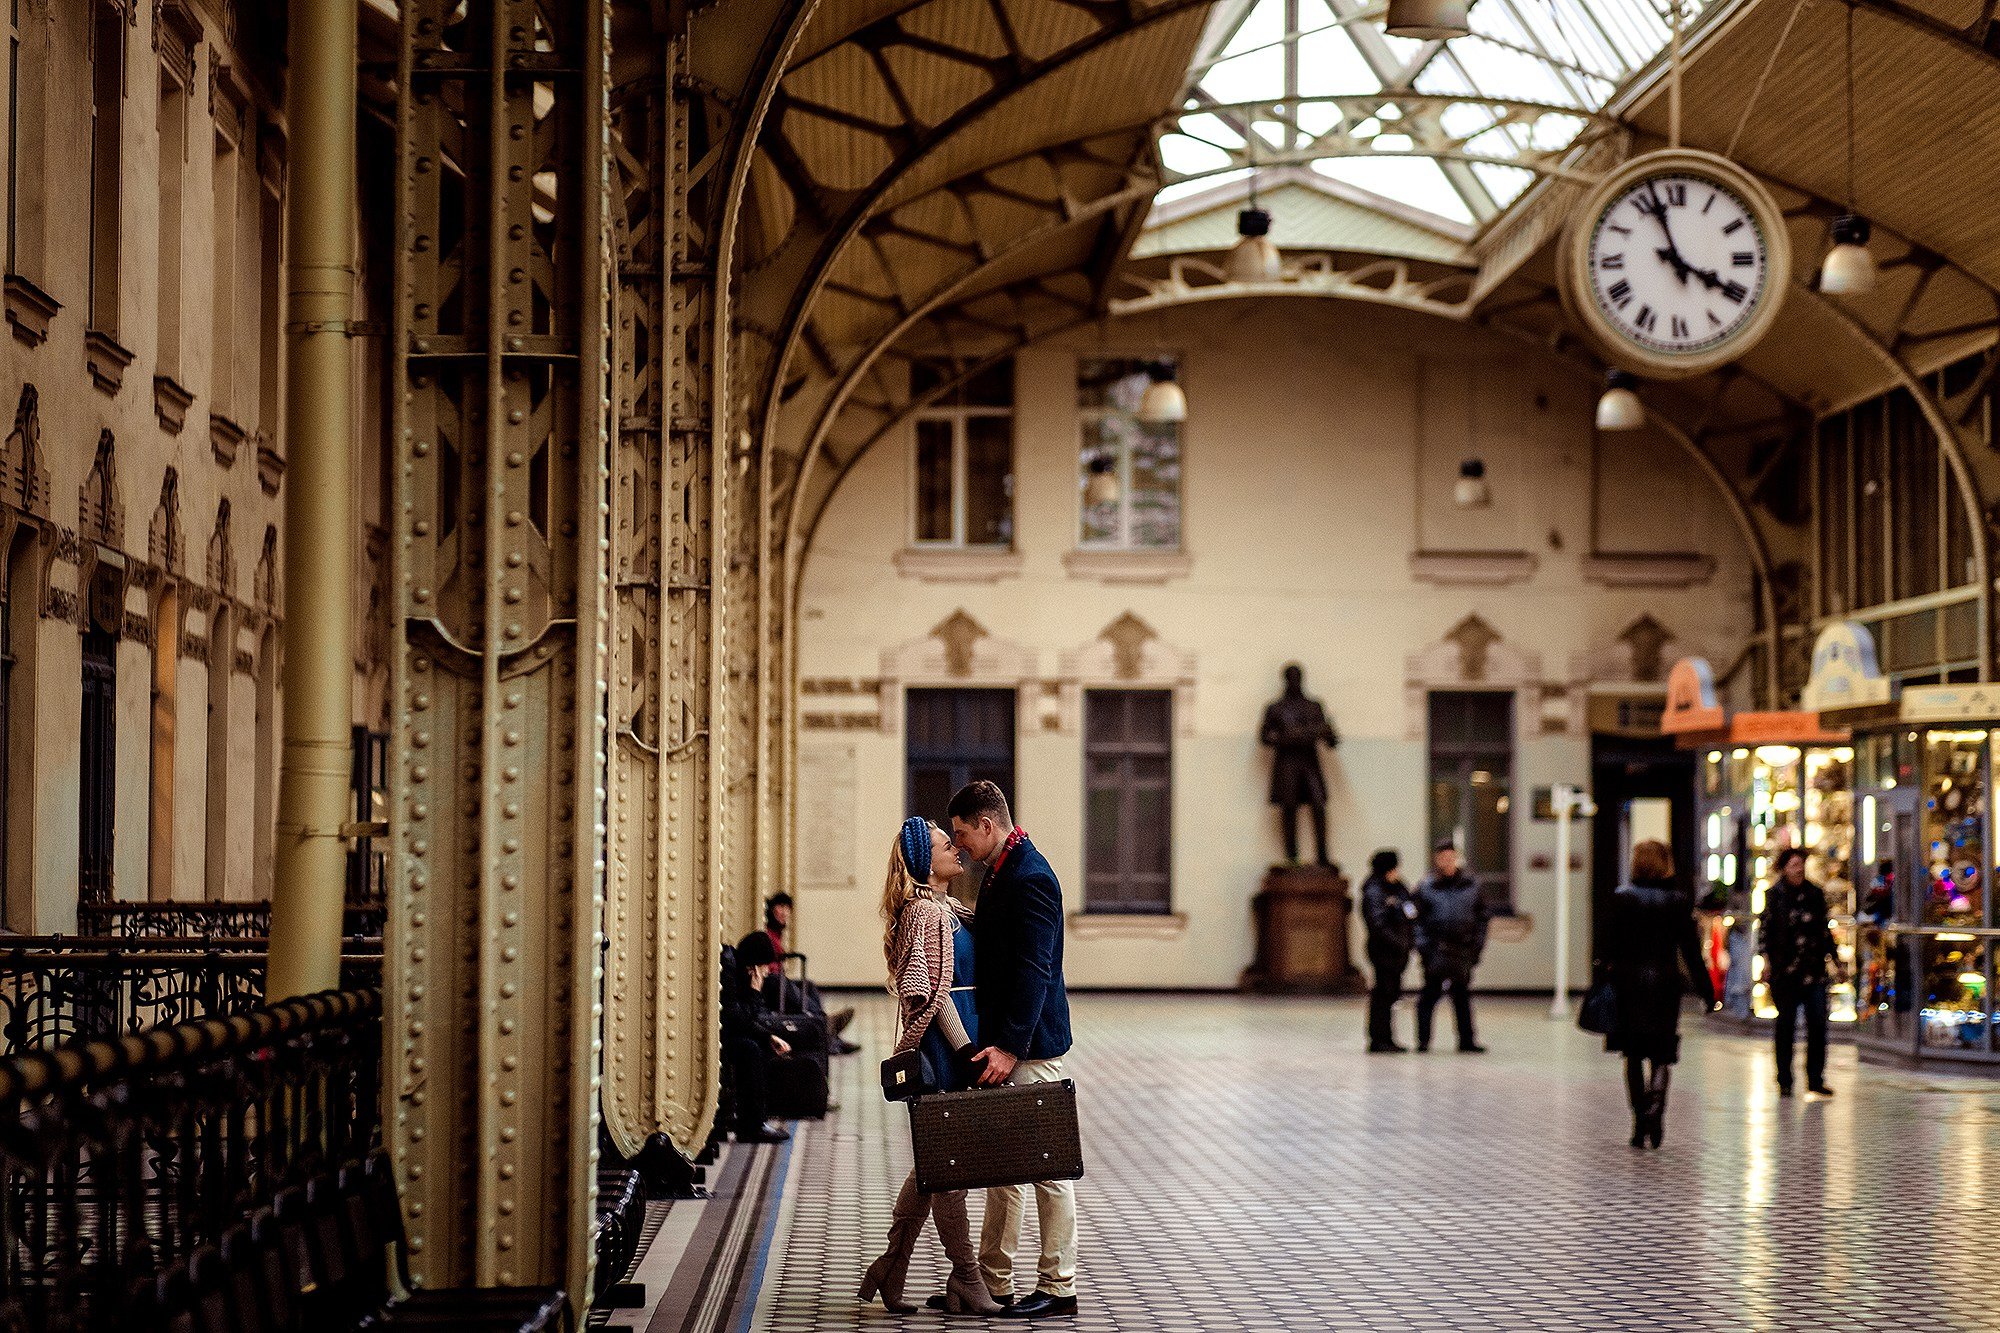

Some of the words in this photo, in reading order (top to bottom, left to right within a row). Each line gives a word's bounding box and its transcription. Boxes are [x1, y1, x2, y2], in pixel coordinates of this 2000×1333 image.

[1702, 193, 1716, 214] I
[1722, 218, 1744, 235] II
[1732, 251, 1755, 267] III
